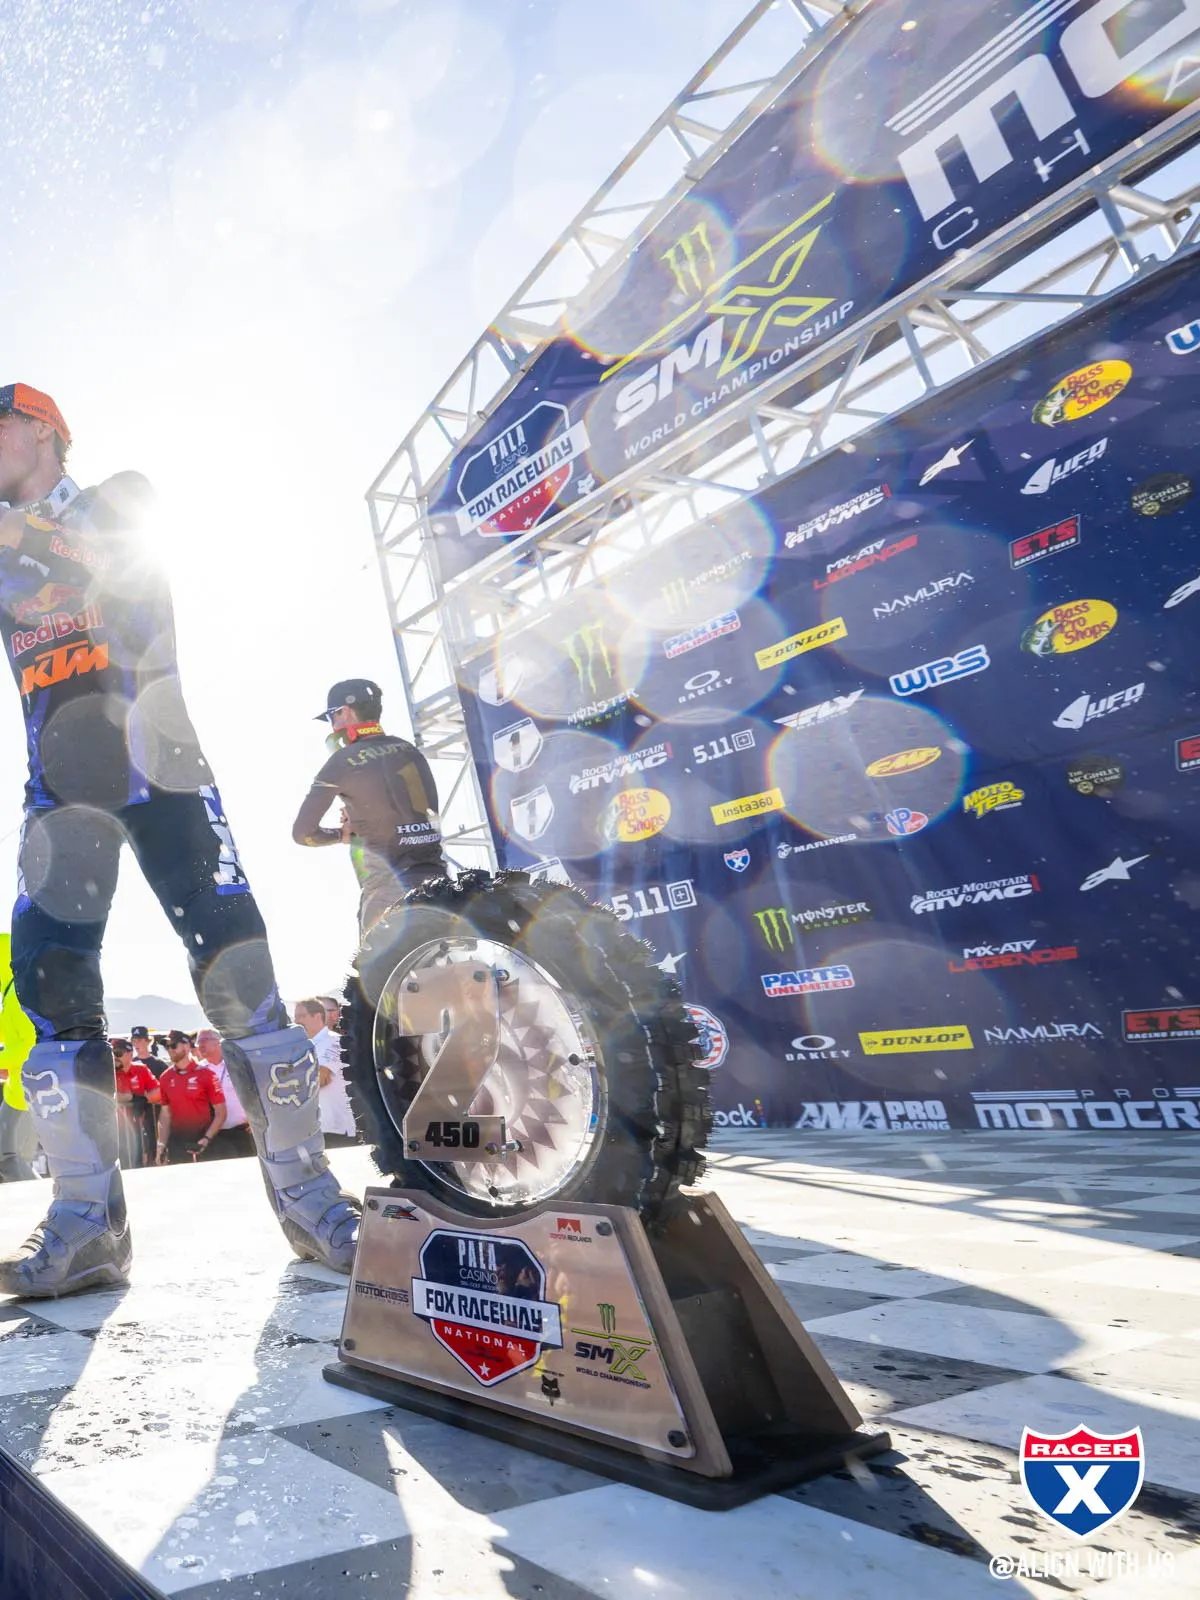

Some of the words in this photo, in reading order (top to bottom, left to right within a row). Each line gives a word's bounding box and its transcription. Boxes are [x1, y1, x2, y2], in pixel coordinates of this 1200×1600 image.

[614, 224, 839, 431] SMX
[624, 412, 686, 459] WORLD
[690, 300, 854, 417] CHAMPIONSHIP
[1066, 365, 1104, 390] Bass
[1076, 379, 1125, 411] Shops
[489, 424, 526, 466] PALA
[1053, 437, 1108, 479] UFO
[493, 444, 528, 475] CASINO
[467, 492, 497, 519] FOX
[495, 435, 573, 504] RACEWAY
[488, 476, 562, 528] NATIONAL
[797, 513, 827, 534] ROCKY
[828, 485, 881, 518] MOUNTAIN
[49, 535, 81, 561] Red
[1012, 518, 1079, 559] ETS
[1049, 537, 1077, 552] FUELS
[813, 535, 919, 591] LEGENDS
[826, 539, 886, 574] MX-ATV
[872, 572, 974, 618] NAMURA
[1053, 602, 1090, 623] Bass
[1060, 617, 1087, 633] Pro
[11, 616, 53, 656] Red
[56, 605, 104, 640] Bull
[664, 611, 738, 651] PARTS
[773, 624, 841, 659] DUNLOP
[1064, 620, 1110, 646] Shops
[20, 640, 109, 696] KTM
[891, 645, 989, 695] WPS
[678, 677, 733, 704] OAKLEY
[1087, 682, 1145, 717] UFO
[567, 687, 640, 725] MONSTER
[774, 688, 865, 728] FLY
[582, 762, 613, 778] ROCKY
[614, 743, 664, 767] MOUNTAIN
[692, 736, 734, 765] 5.11
[618, 791, 649, 807] Bass
[722, 795, 773, 819] Insta360
[963, 781, 1014, 809] MOTO
[976, 789, 1024, 818] TEES
[623, 805, 646, 821] Pro
[627, 814, 665, 834] Shops
[794, 833, 857, 854] MARINES
[926, 886, 959, 900] ROCKY
[962, 875, 1029, 894] MOUNTAIN
[611, 886, 669, 921] 5.11
[791, 901, 871, 926] MONSTER
[804, 916, 858, 930] ENERGY
[948, 946, 1078, 973] LEGENDS
[963, 939, 1037, 959] MX-ATV
[763, 965, 852, 988] PARTS
[767, 979, 855, 997] UNLIMITED
[984, 1021, 1103, 1044] NAMURA
[1126, 1008, 1200, 1033] ETS
[881, 1032, 965, 1047] DUNLOP
[785, 1049, 851, 1062] OAKLEY
[1081, 1088, 1170, 1099] PRO
[796, 1101, 887, 1130] AMA
[885, 1100, 948, 1120] PRO
[891, 1121, 950, 1131] RACING
[424, 1120, 480, 1149] 450
[458, 1239, 497, 1271] PALA
[460, 1268, 499, 1284] CASINO
[355, 1284, 408, 1302] MOTOCROSS
[425, 1288, 455, 1314] FOX
[458, 1294, 543, 1333] RACEWAY
[444, 1326, 525, 1353] NATIONAL
[575, 1341, 650, 1380] SMX
[576, 1366, 598, 1377] WORLD
[600, 1370, 651, 1389] CHAMPIONSHIP
